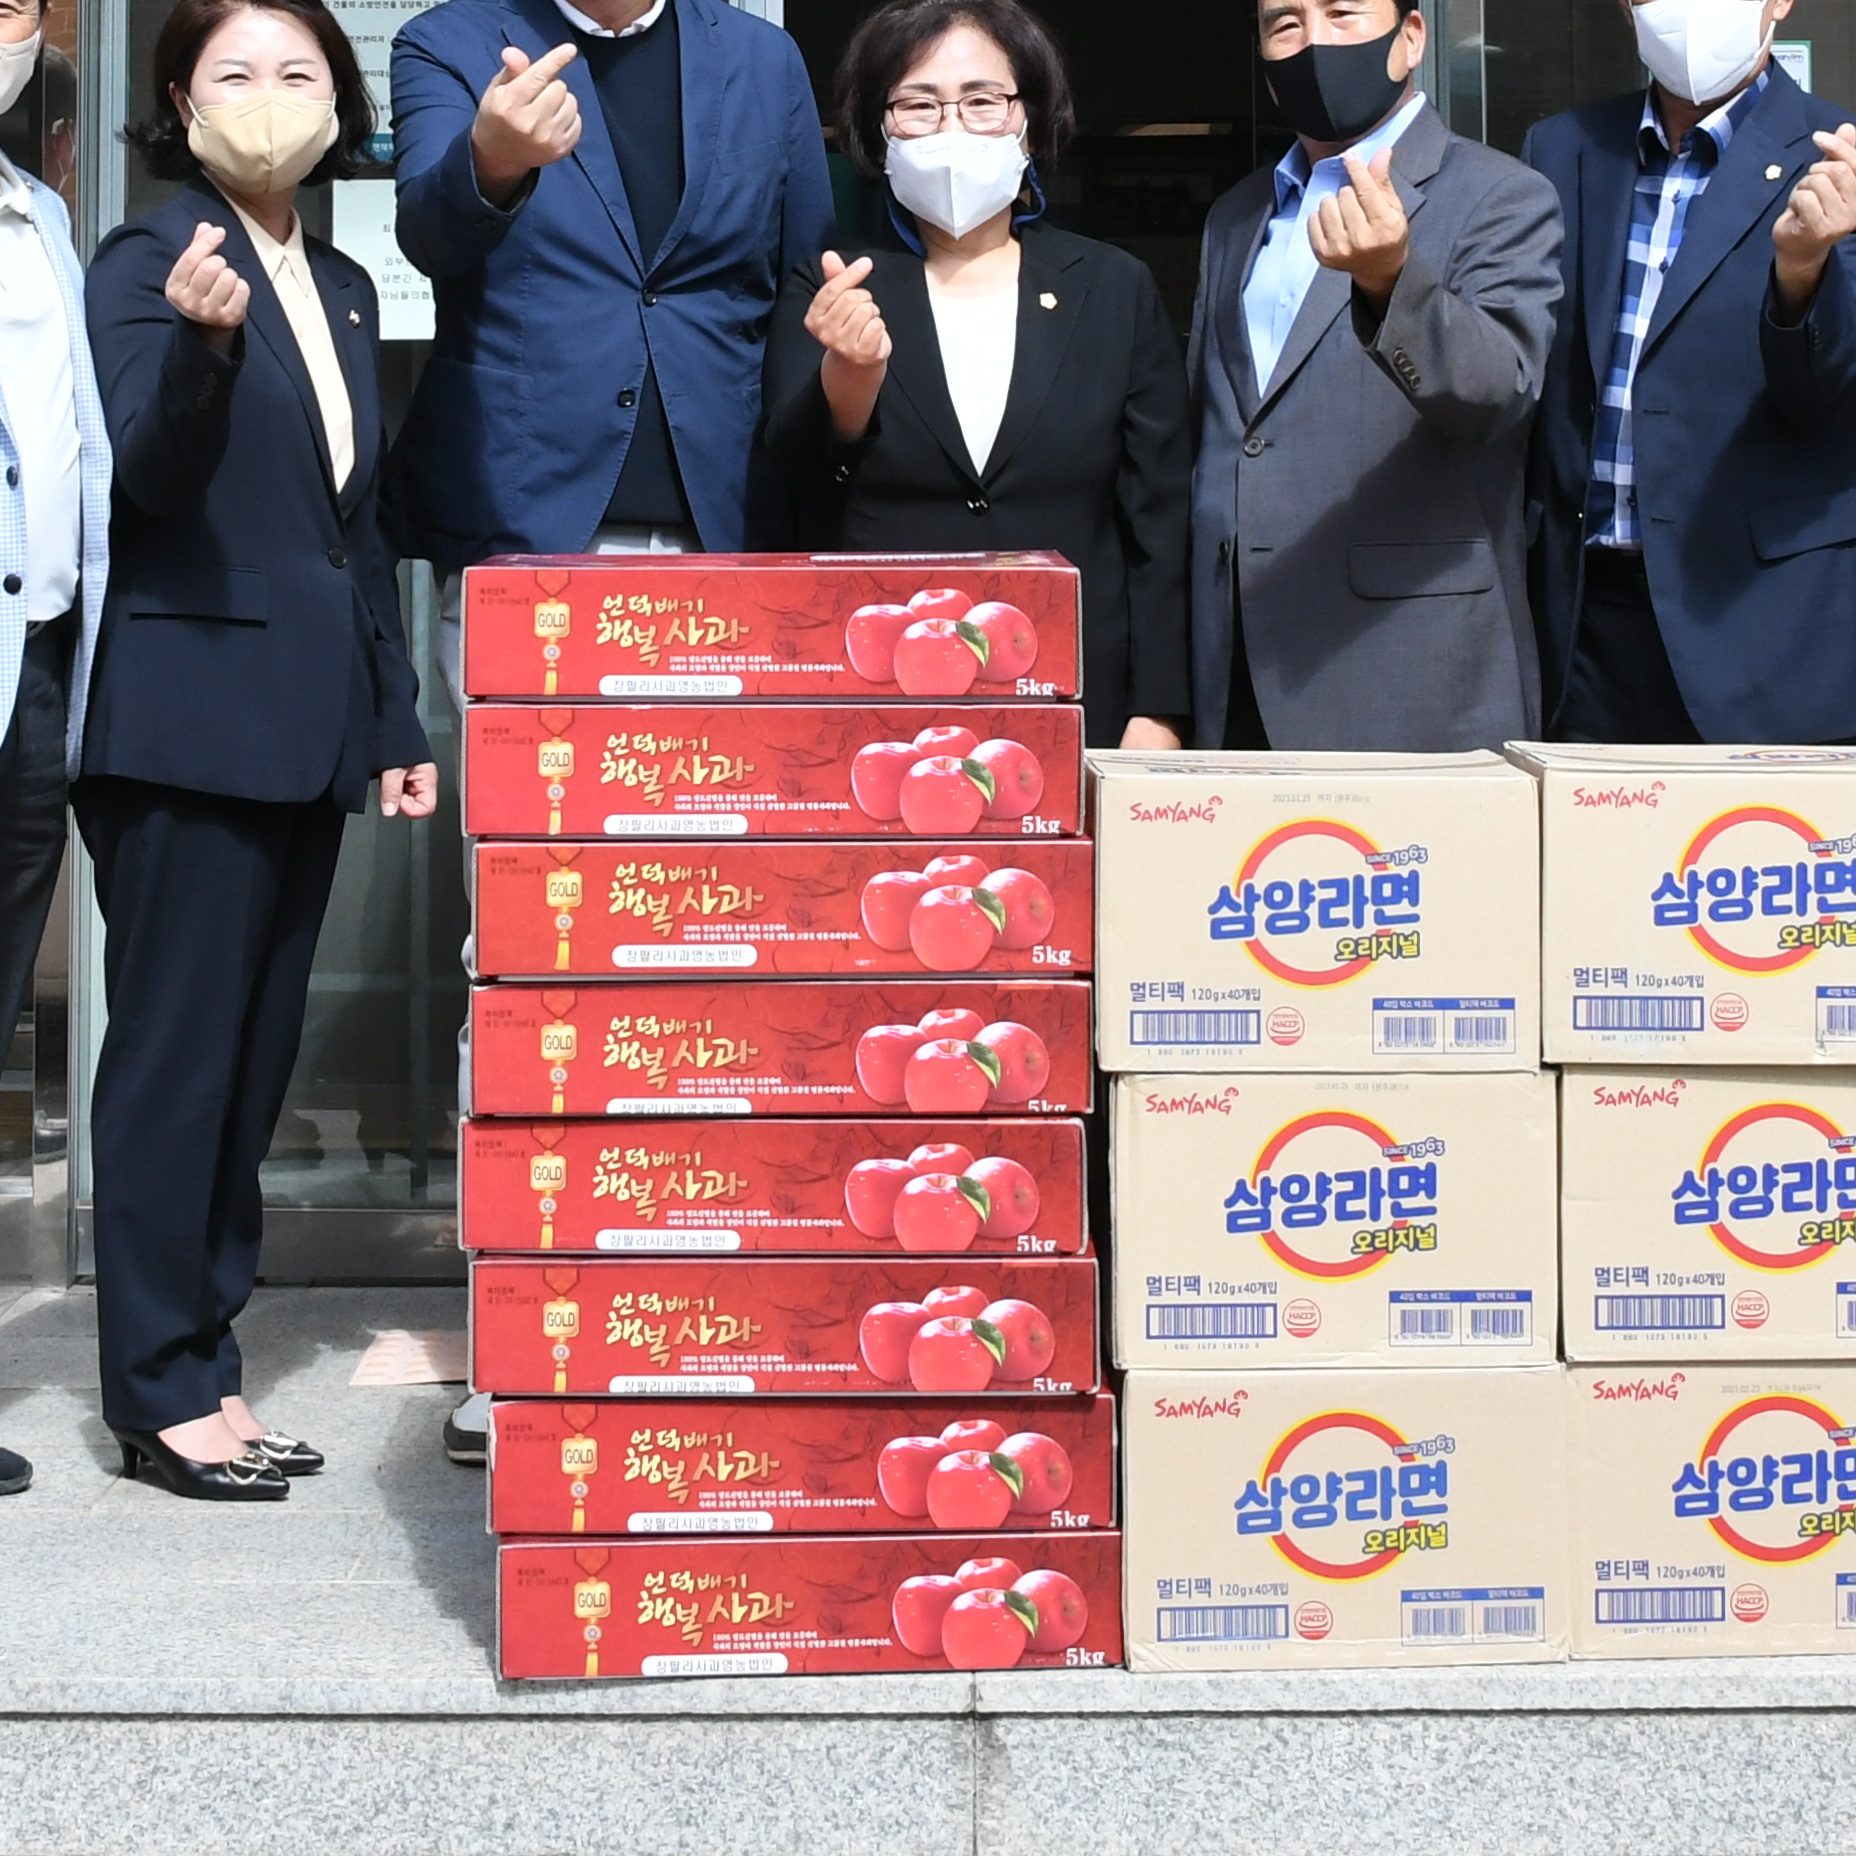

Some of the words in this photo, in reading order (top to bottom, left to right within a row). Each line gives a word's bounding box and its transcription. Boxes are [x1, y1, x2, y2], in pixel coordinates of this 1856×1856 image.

[602, 594, 704, 617] 언덕배기
[537, 612, 566, 628] GOLD
[1014, 677, 1054, 696] 5kg
[606, 732, 708, 755] 언덕배기
[541, 752, 570, 767] GOLD
[1572, 786, 1658, 808] SAMYANG
[1130, 800, 1215, 823] SAMYANG
[1021, 815, 1061, 833] 5kg
[1392, 844, 1428, 866] 1963
[614, 862, 717, 885] 언덕배기
[549, 882, 578, 898] GOLD
[1207, 869, 1420, 940] 삼양라면
[1032, 945, 1072, 966] 5kg
[1334, 931, 1419, 961] 오리지널
[1572, 967, 1628, 988] 멀티팩
[1129, 981, 1185, 1003] 멀티팩
[609, 1015, 712, 1038] 언덕배기
[544, 1034, 573, 1050] GOLD
[1145, 1091, 1231, 1115] SAMYANG
[1593, 1084, 1679, 1108] SAMYANG
[598, 1146, 701, 1170] 언덕배기
[1409, 1136, 1445, 1158] 1963
[533, 1165, 562, 1181] GOLD
[1223, 1162, 1437, 1233] 삼양라면
[1016, 1234, 1057, 1252] 5kg
[1351, 1223, 1436, 1254] 오리지널
[1144, 1274, 1201, 1296] 멀티팩
[1593, 1265, 1649, 1288] 멀티팩
[611, 1292, 715, 1315] 언덕배기
[546, 1311, 575, 1328] GOLD
[1593, 1376, 1679, 1401] SAMYANG
[1154, 1394, 1241, 1420] SAMYANG
[630, 1428, 733, 1452] 언덕배기
[1419, 1434, 1456, 1457] 1963
[564, 1448, 593, 1465] GOLD
[1233, 1460, 1448, 1536] 삼양라면
[1050, 1510, 1090, 1527] 5kg
[1362, 1522, 1447, 1554] 오리지널
[1594, 1559, 1649, 1581] 멀티팩
[643, 1569, 747, 1595] 언덕배기
[1156, 1577, 1212, 1600] 멀티팩
[577, 1592, 606, 1609] GOLD
[1065, 1647, 1106, 1666] 5kg
